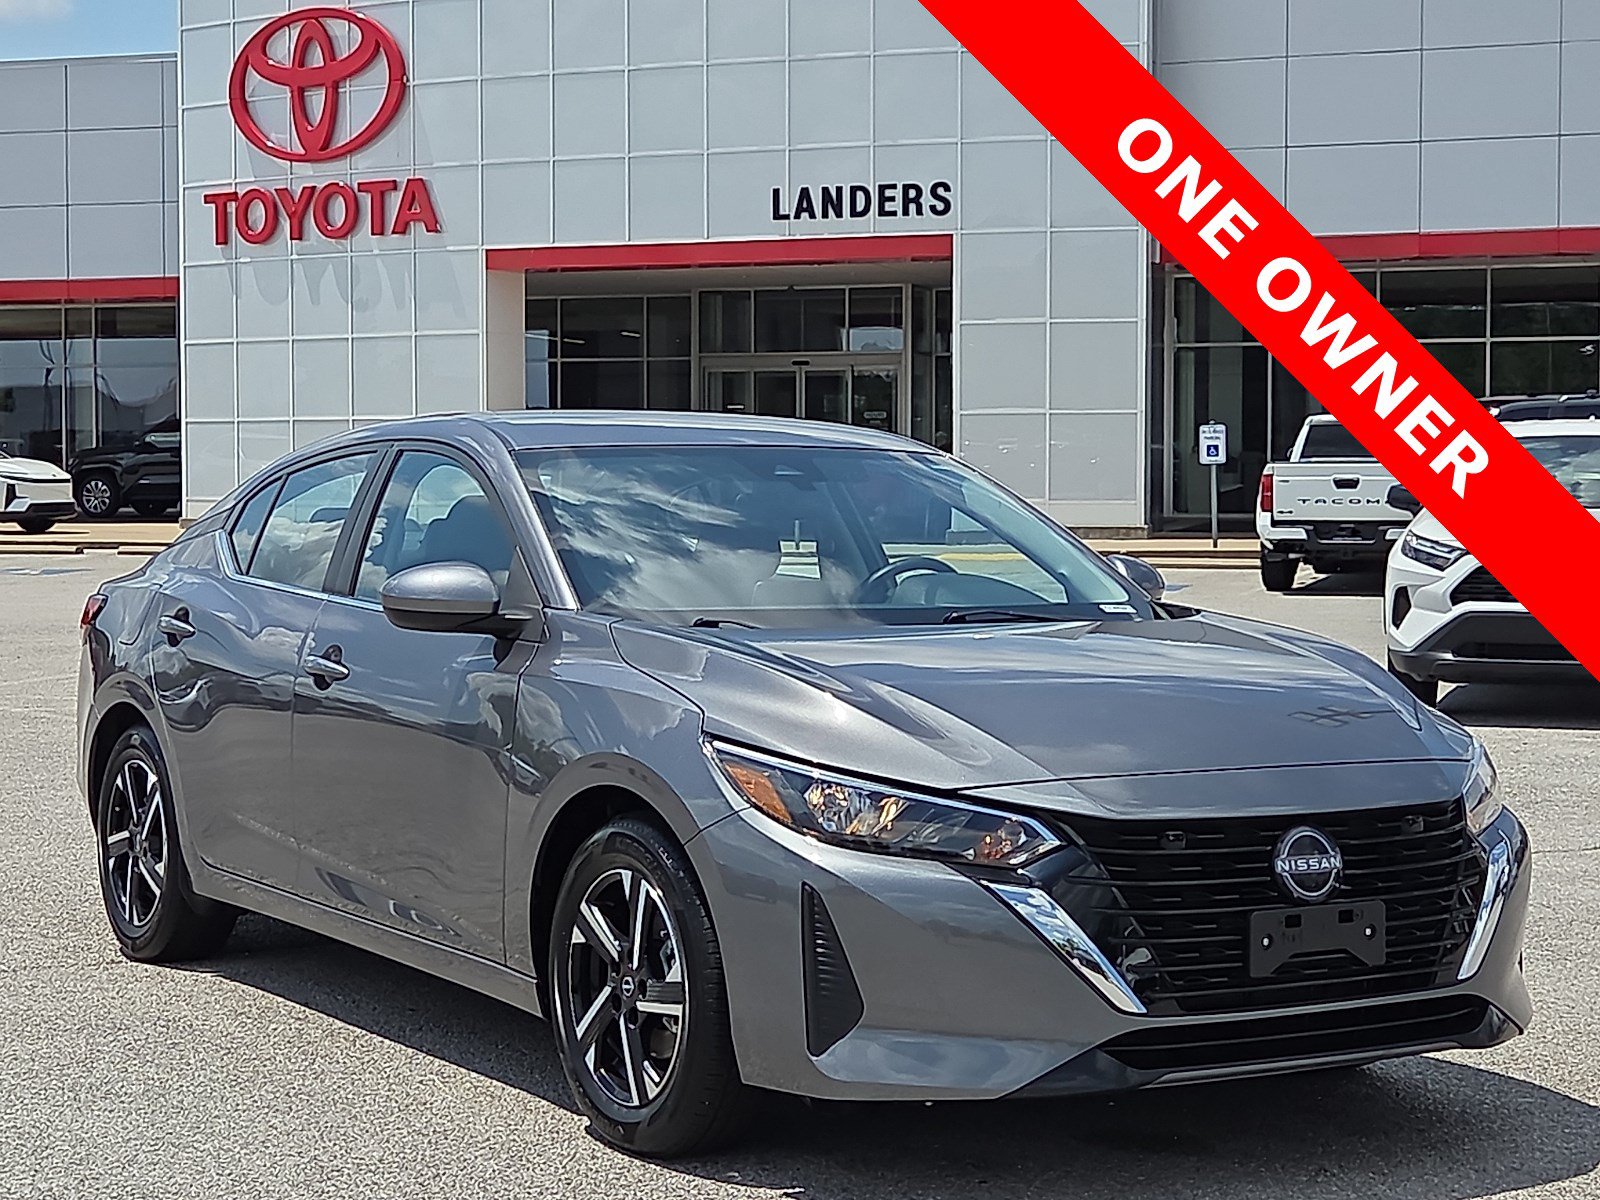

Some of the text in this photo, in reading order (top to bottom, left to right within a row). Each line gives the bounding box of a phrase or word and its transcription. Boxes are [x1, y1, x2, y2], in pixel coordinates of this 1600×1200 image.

[204, 178, 440, 245] TOYOTA
[772, 181, 952, 221] LANDERS
[1277, 857, 1341, 871] NISSAN
